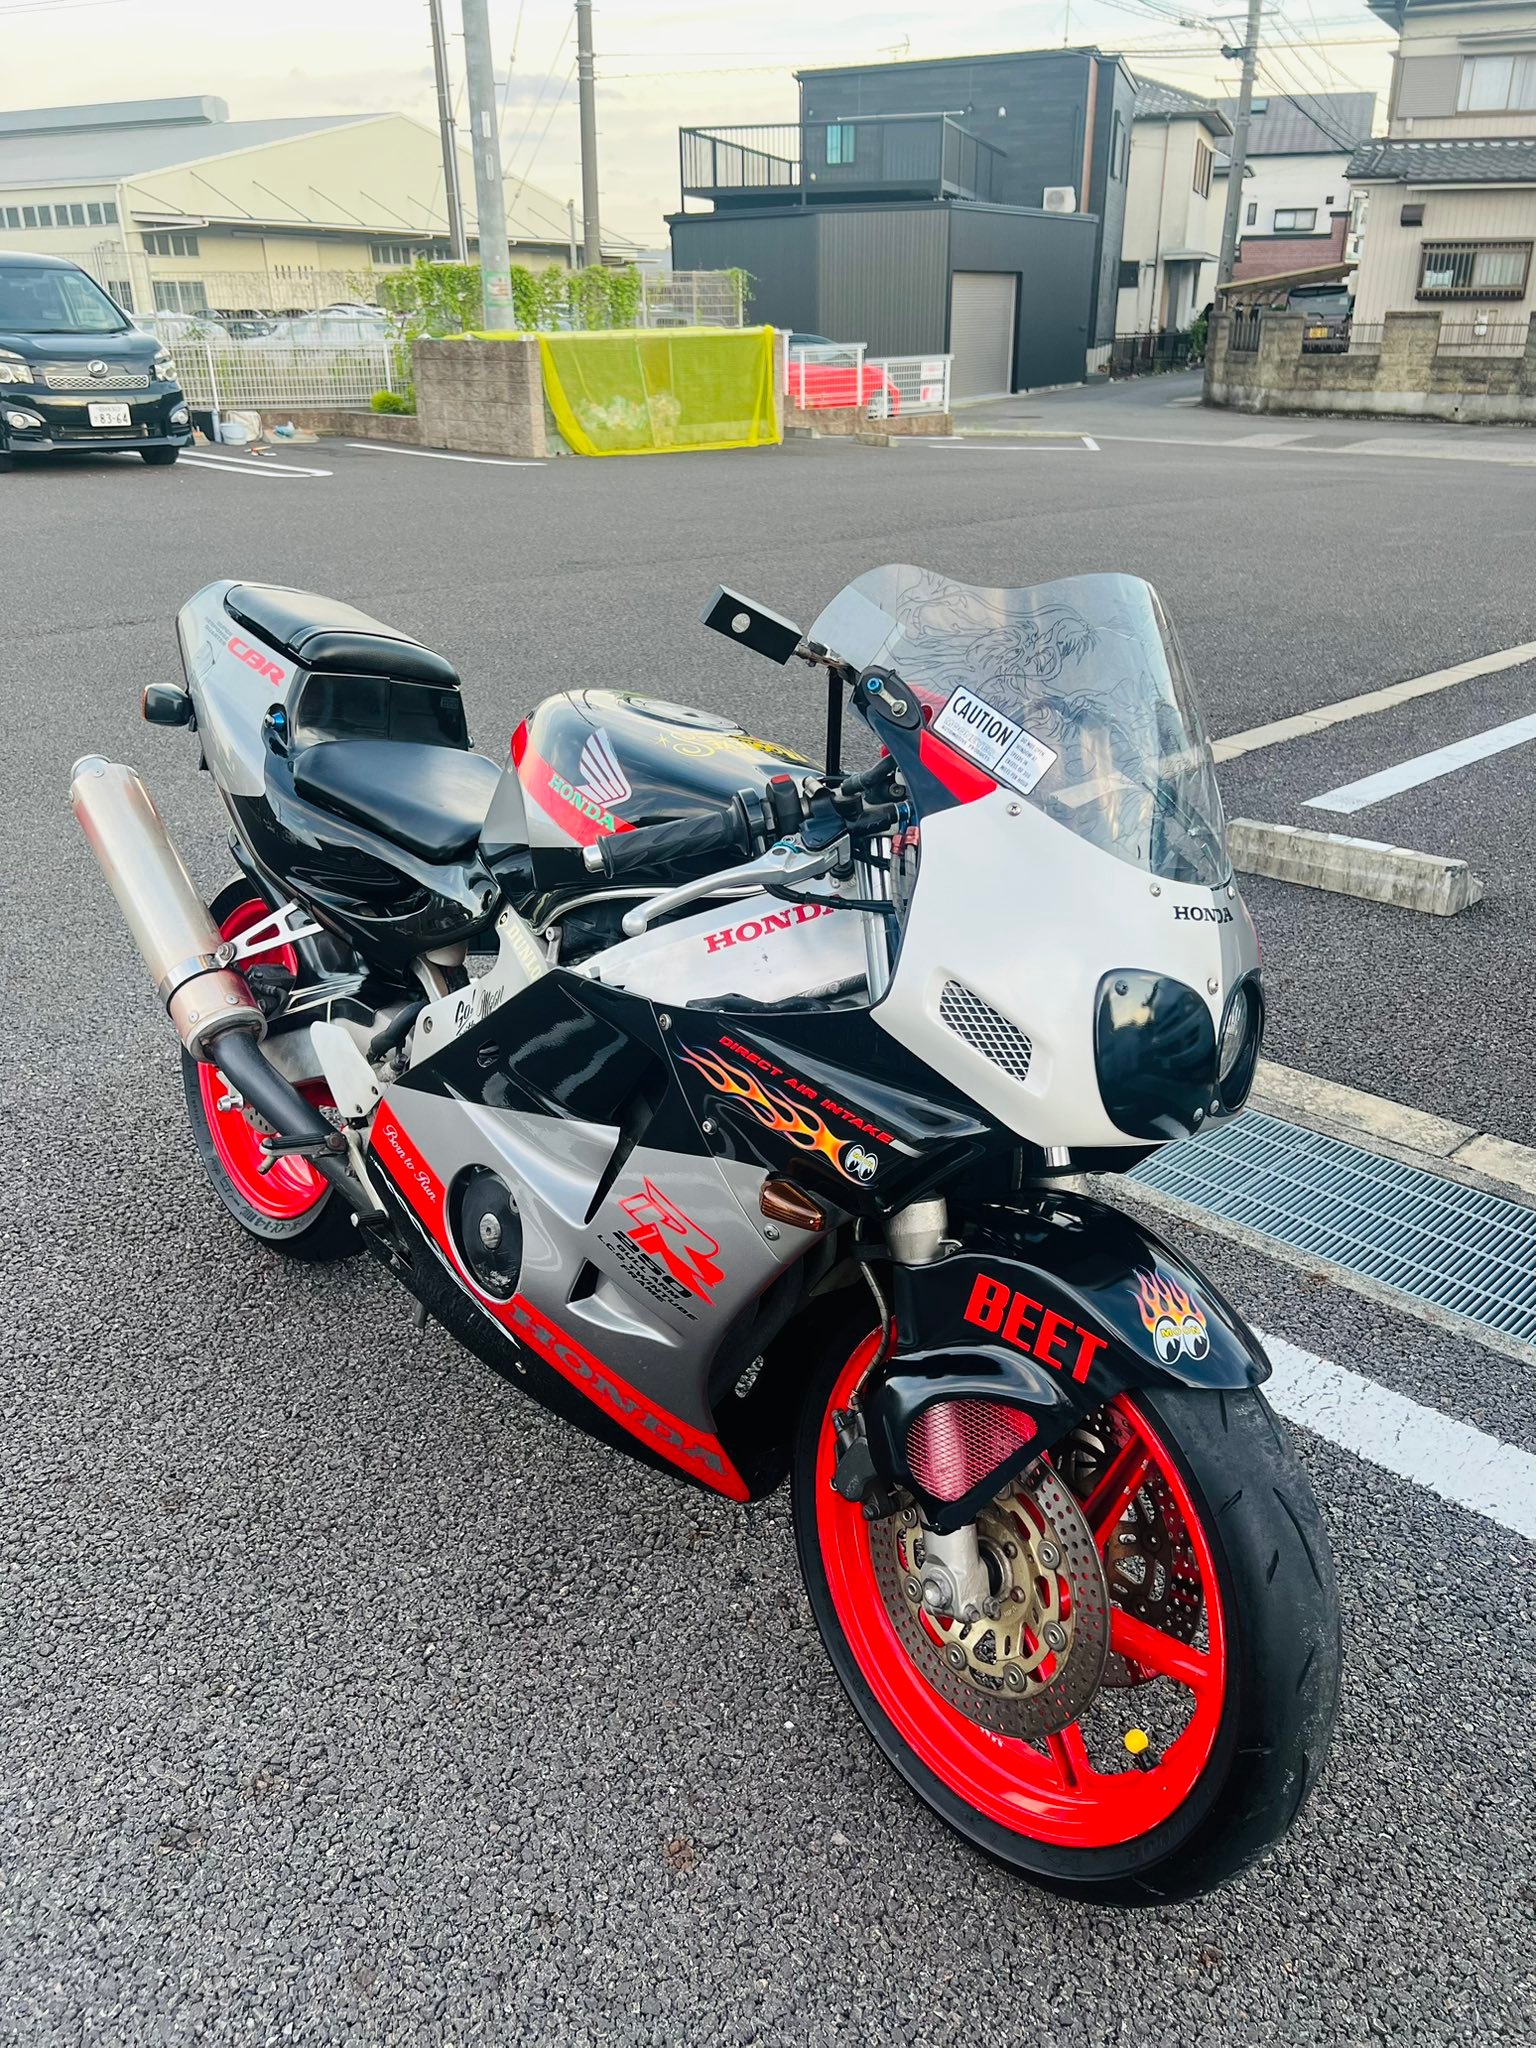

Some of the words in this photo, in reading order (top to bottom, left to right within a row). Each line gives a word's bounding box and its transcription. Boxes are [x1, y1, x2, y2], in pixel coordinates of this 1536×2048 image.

[227, 636, 286, 688] CBR
[952, 696, 1014, 746] CAUTION
[548, 774, 616, 832] HONDA
[1173, 905, 1233, 924] HONDA
[718, 1035, 784, 1077] DIRECT
[784, 1077, 819, 1100] AIR
[820, 1098, 895, 1145] INTAKE
[382, 1124, 407, 1159] Born
[403, 1157, 416, 1171] to
[413, 1171, 437, 1204] Run
[612, 1230, 693, 1298] 250
[616, 1244, 648, 1274] GULL
[648, 1275, 681, 1300] ARM
[620, 1263, 667, 1304] FRAME
[963, 1272, 1109, 1385] BEET
[1159, 1325, 1202, 1338] MOON
[511, 1303, 729, 1477] HONDA
